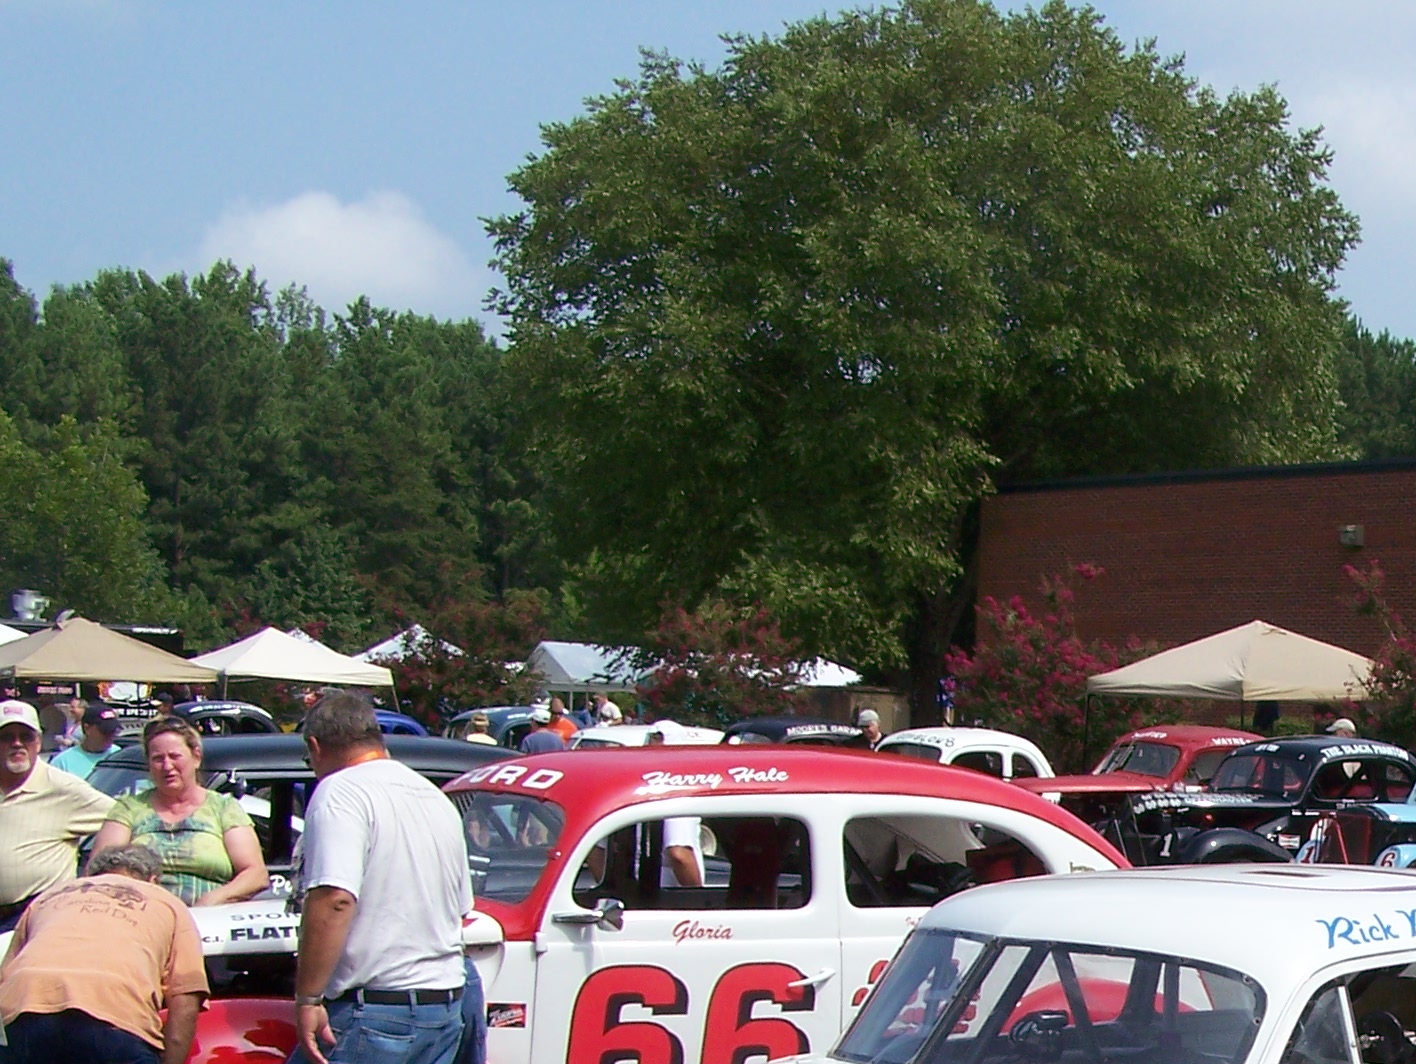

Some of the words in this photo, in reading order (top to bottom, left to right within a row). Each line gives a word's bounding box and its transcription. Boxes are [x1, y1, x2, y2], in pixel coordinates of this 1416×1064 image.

[453, 765, 564, 789] FORD
[641, 770, 722, 790] Harry
[728, 766, 789, 783] Hale
[673, 920, 734, 945] Gloria
[1316, 914, 1399, 949] Rick
